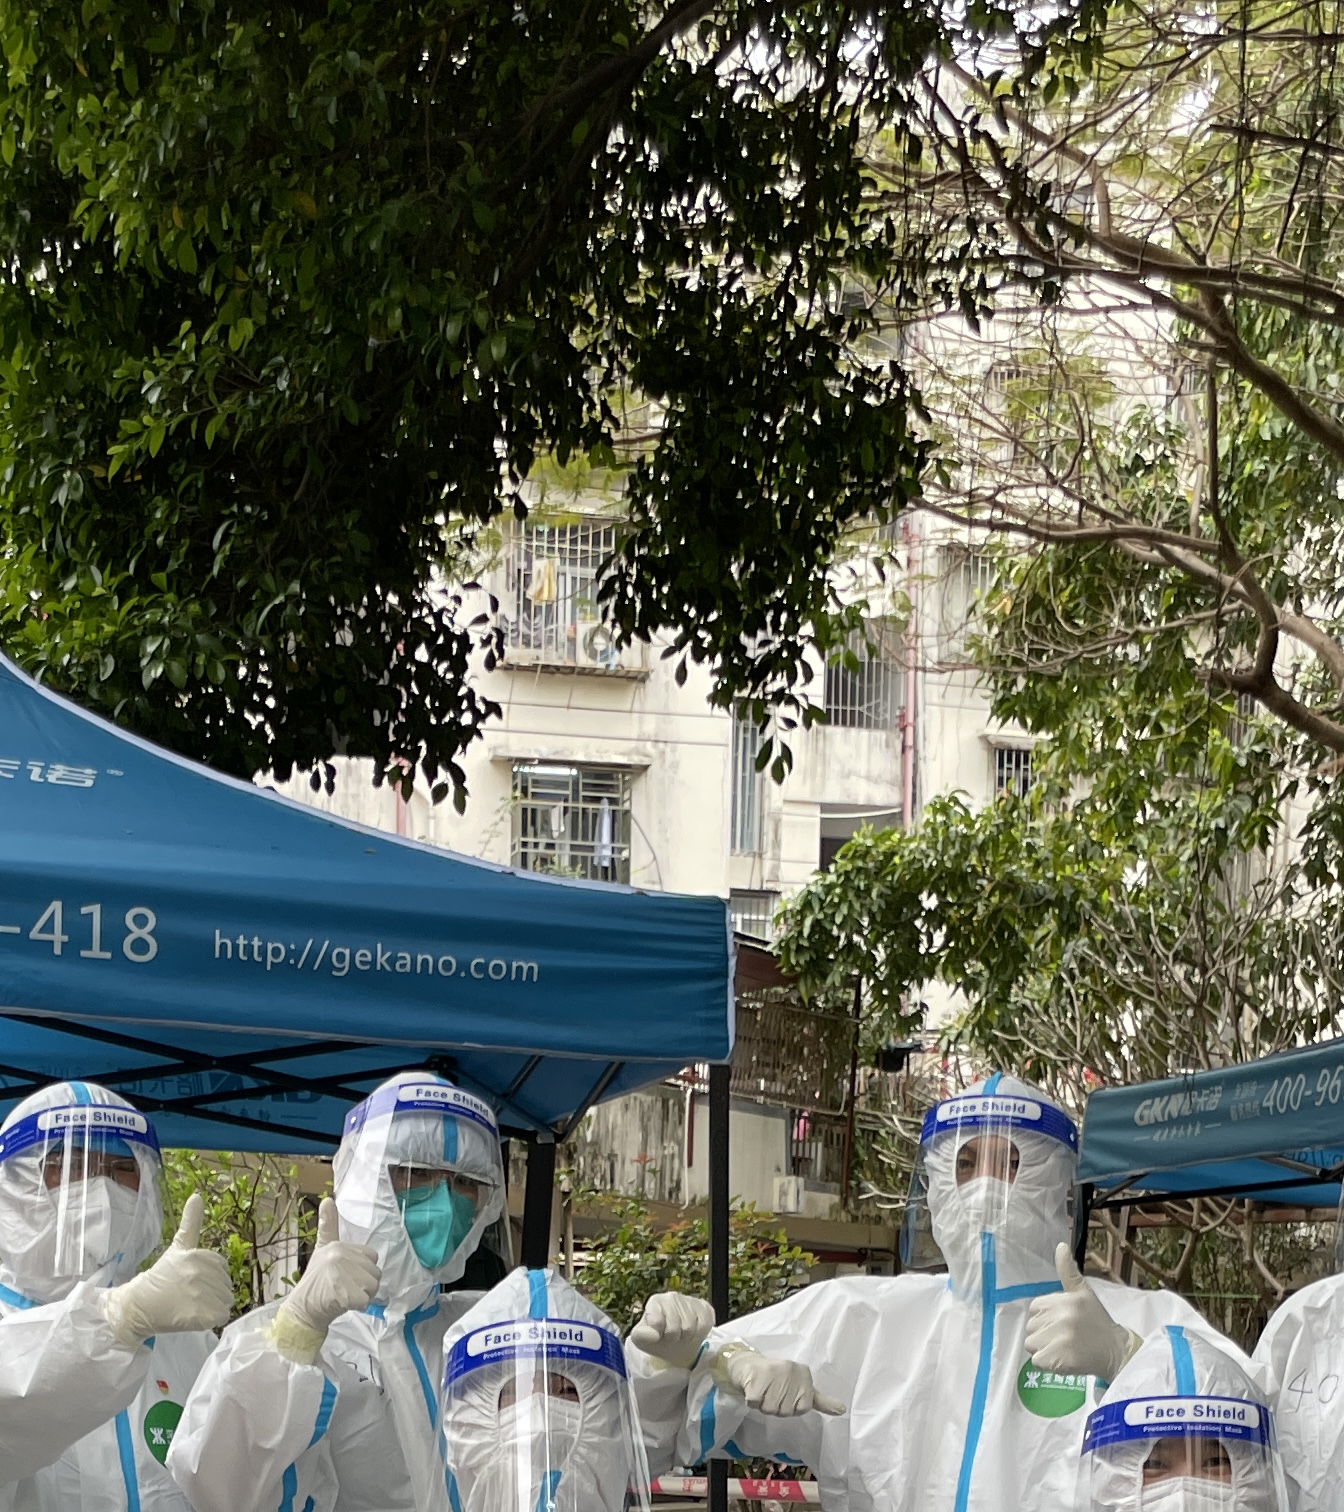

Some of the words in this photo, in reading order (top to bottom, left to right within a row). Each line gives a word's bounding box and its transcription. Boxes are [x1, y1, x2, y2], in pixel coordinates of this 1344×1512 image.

[213, 929, 540, 983] http://gekano.com
[416, 1088, 448, 1099] Face
[453, 1093, 489, 1117] Shield
[55, 1113, 87, 1124] Face
[93, 1111, 136, 1127] Shield
[484, 1332, 521, 1347] Face
[528, 1328, 584, 1342] Shield
[1287, 1367, 1340, 1413] 40
[1144, 1405, 1186, 1419] Face
[1193, 1404, 1246, 1421] Shield
